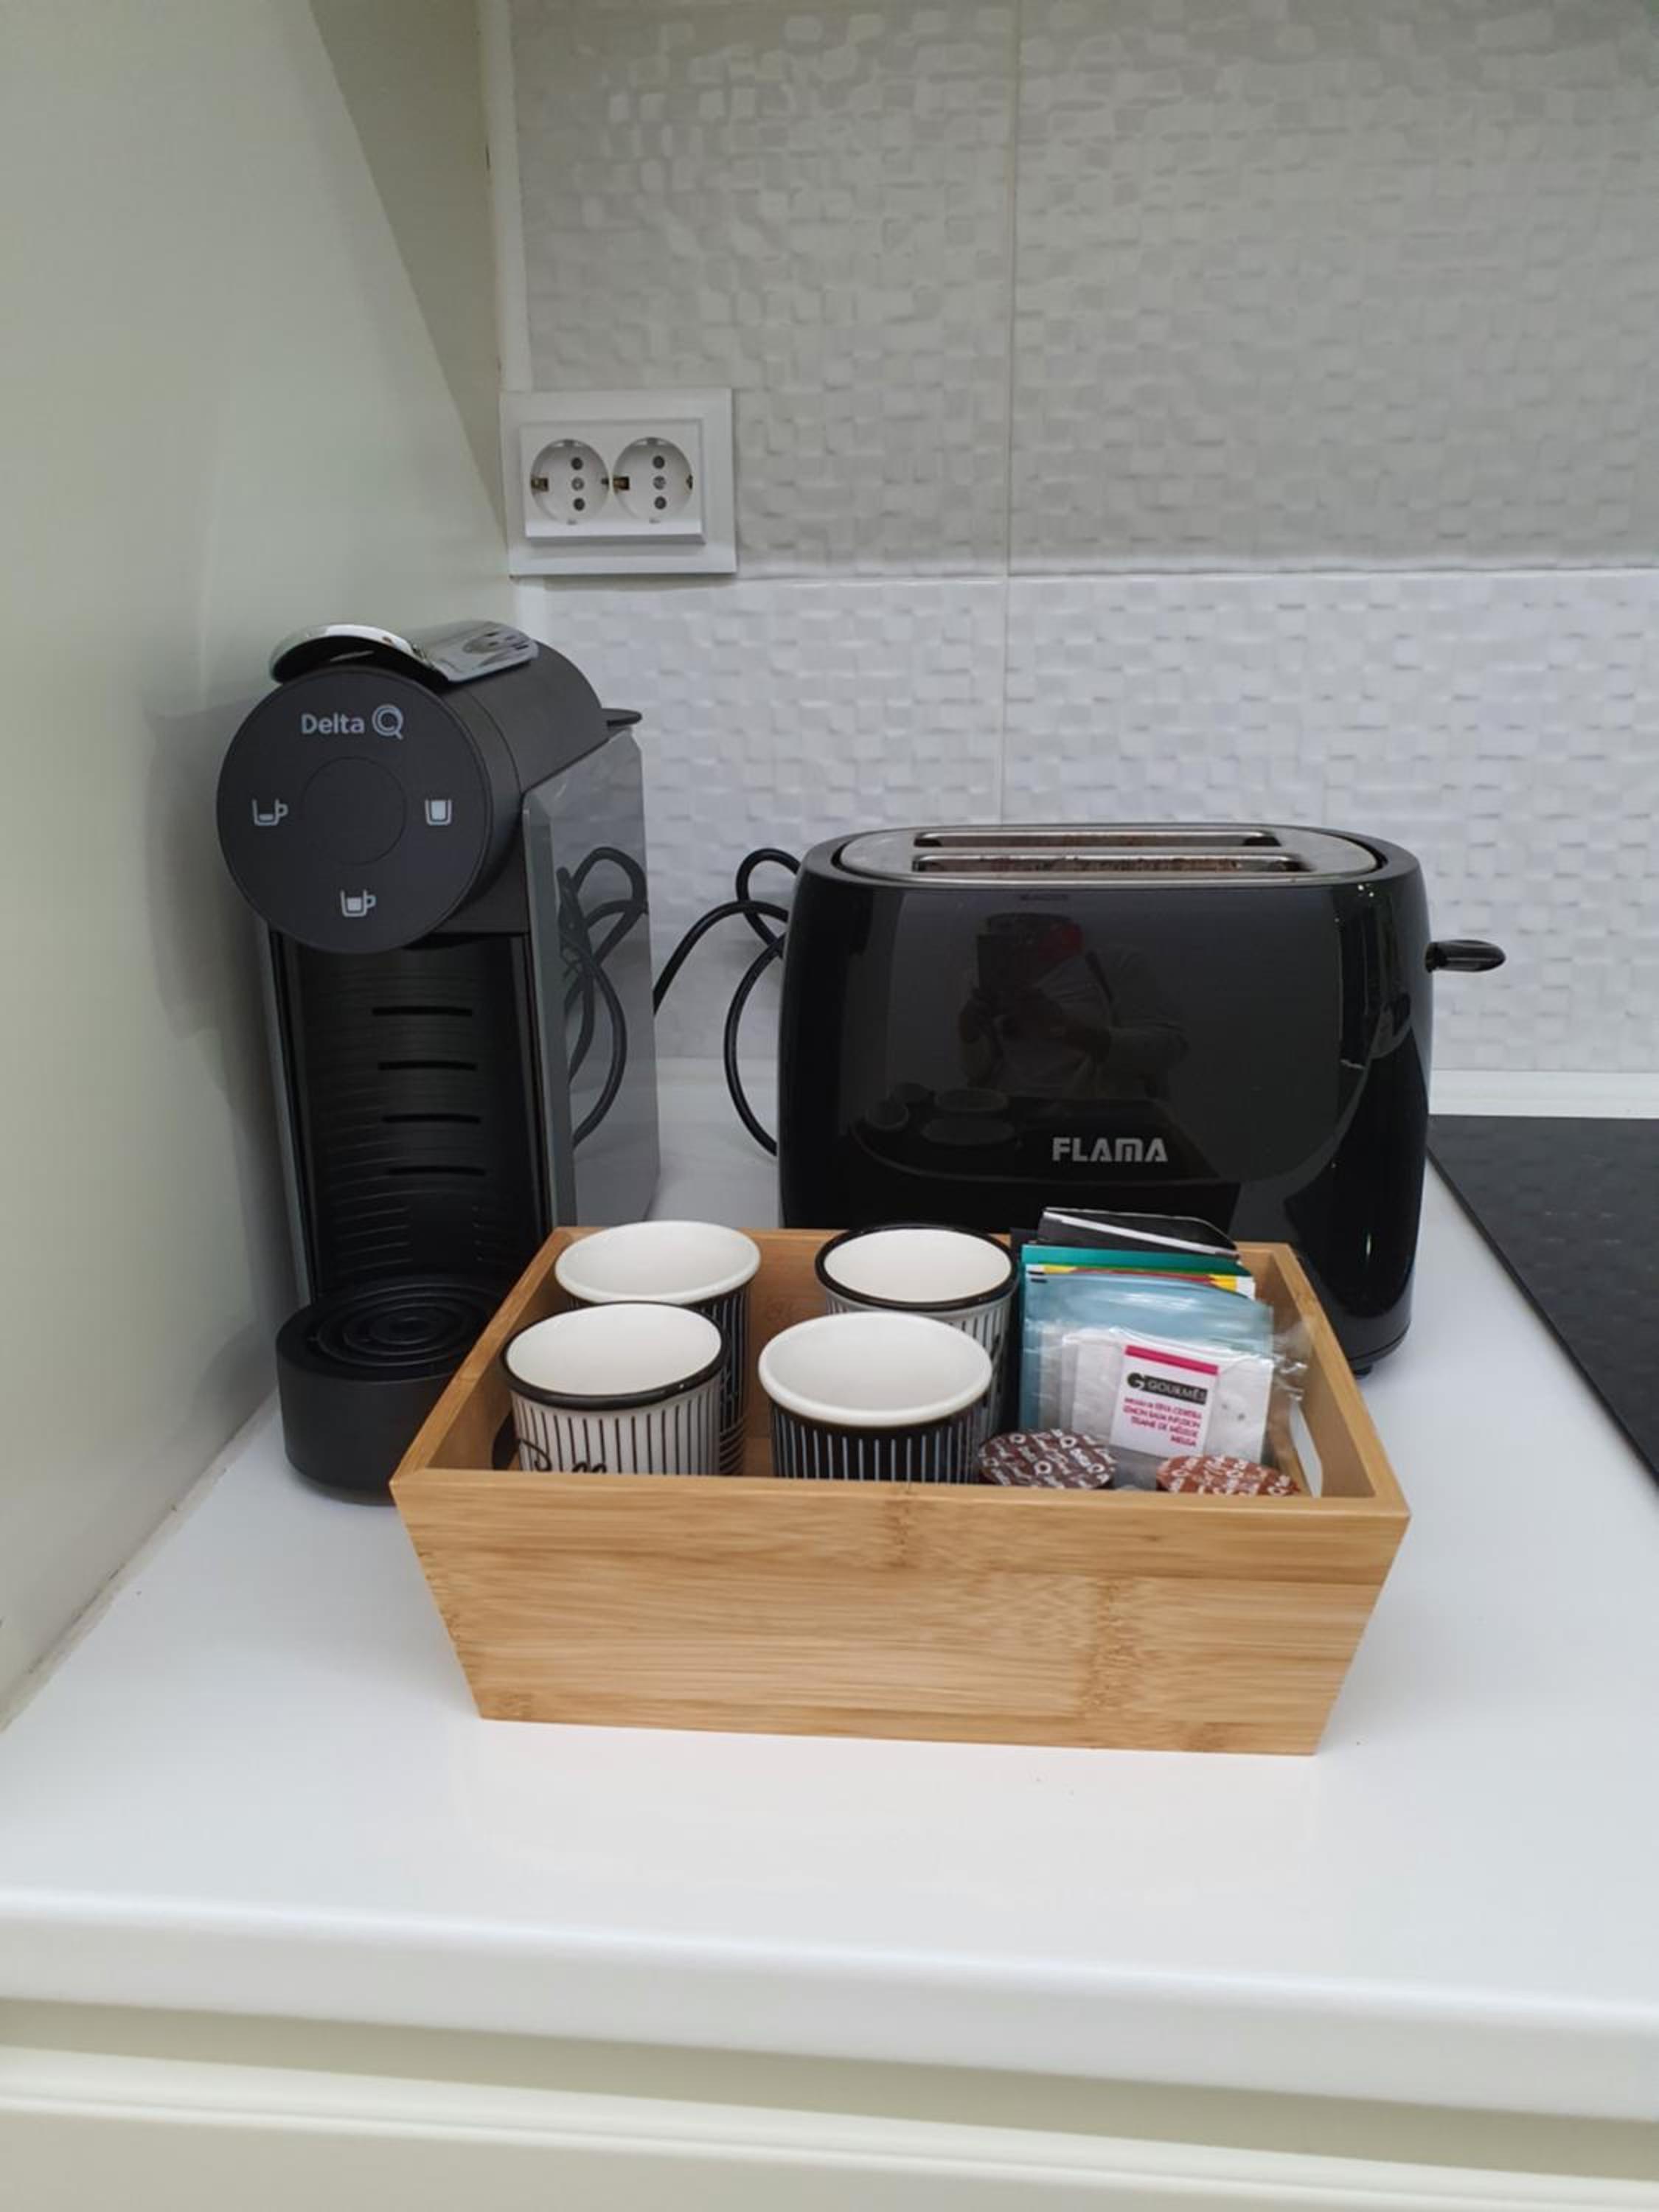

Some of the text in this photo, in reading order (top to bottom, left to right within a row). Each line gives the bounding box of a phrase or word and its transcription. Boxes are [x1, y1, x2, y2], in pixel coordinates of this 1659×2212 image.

[301, 704, 403, 739] Delta Q
[1052, 1137, 1168, 1162] FLAMA
